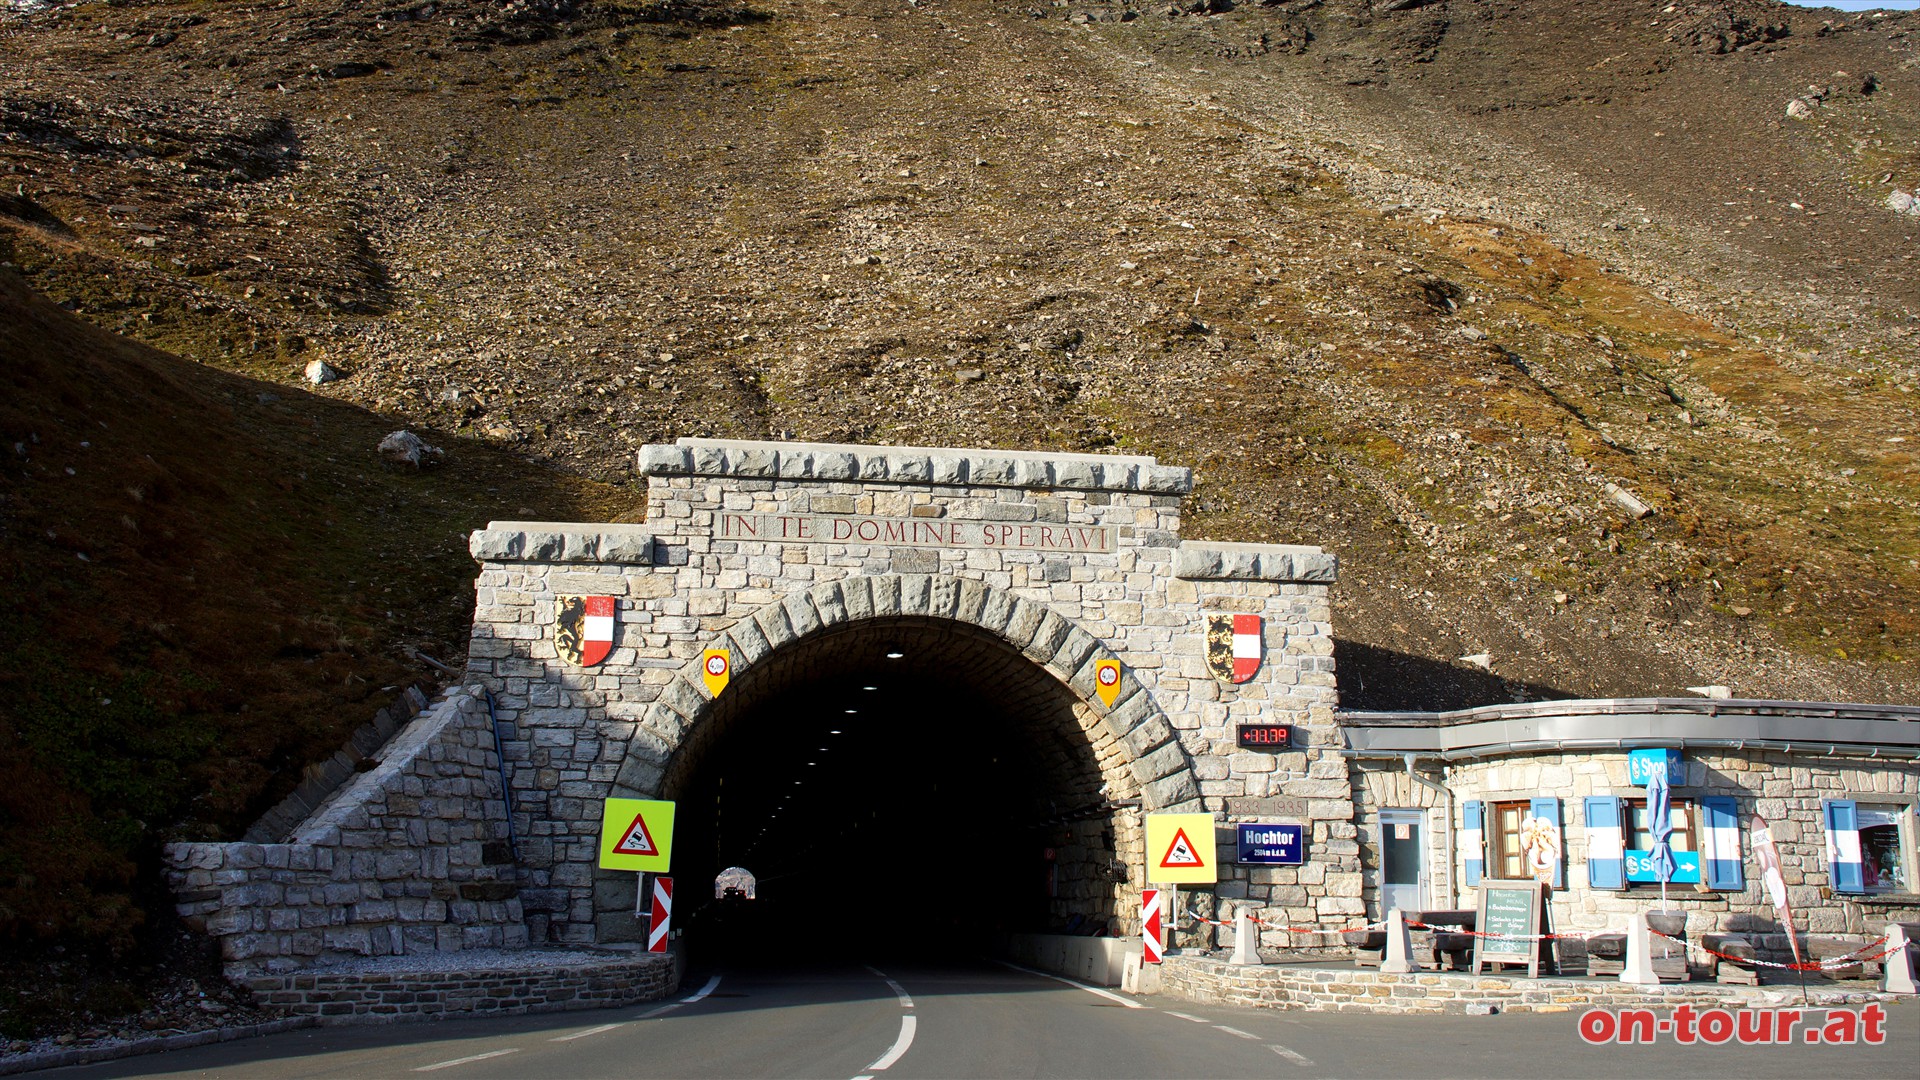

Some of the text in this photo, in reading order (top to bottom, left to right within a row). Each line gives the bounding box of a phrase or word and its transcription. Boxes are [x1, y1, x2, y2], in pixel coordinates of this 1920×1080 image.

[725, 515, 1108, 550] IN TE DOMINE SPERAVI
[1229, 801, 1260, 814] 1933
[1273, 801, 1304, 814] 1935
[1245, 830, 1295, 845] Hochtor
